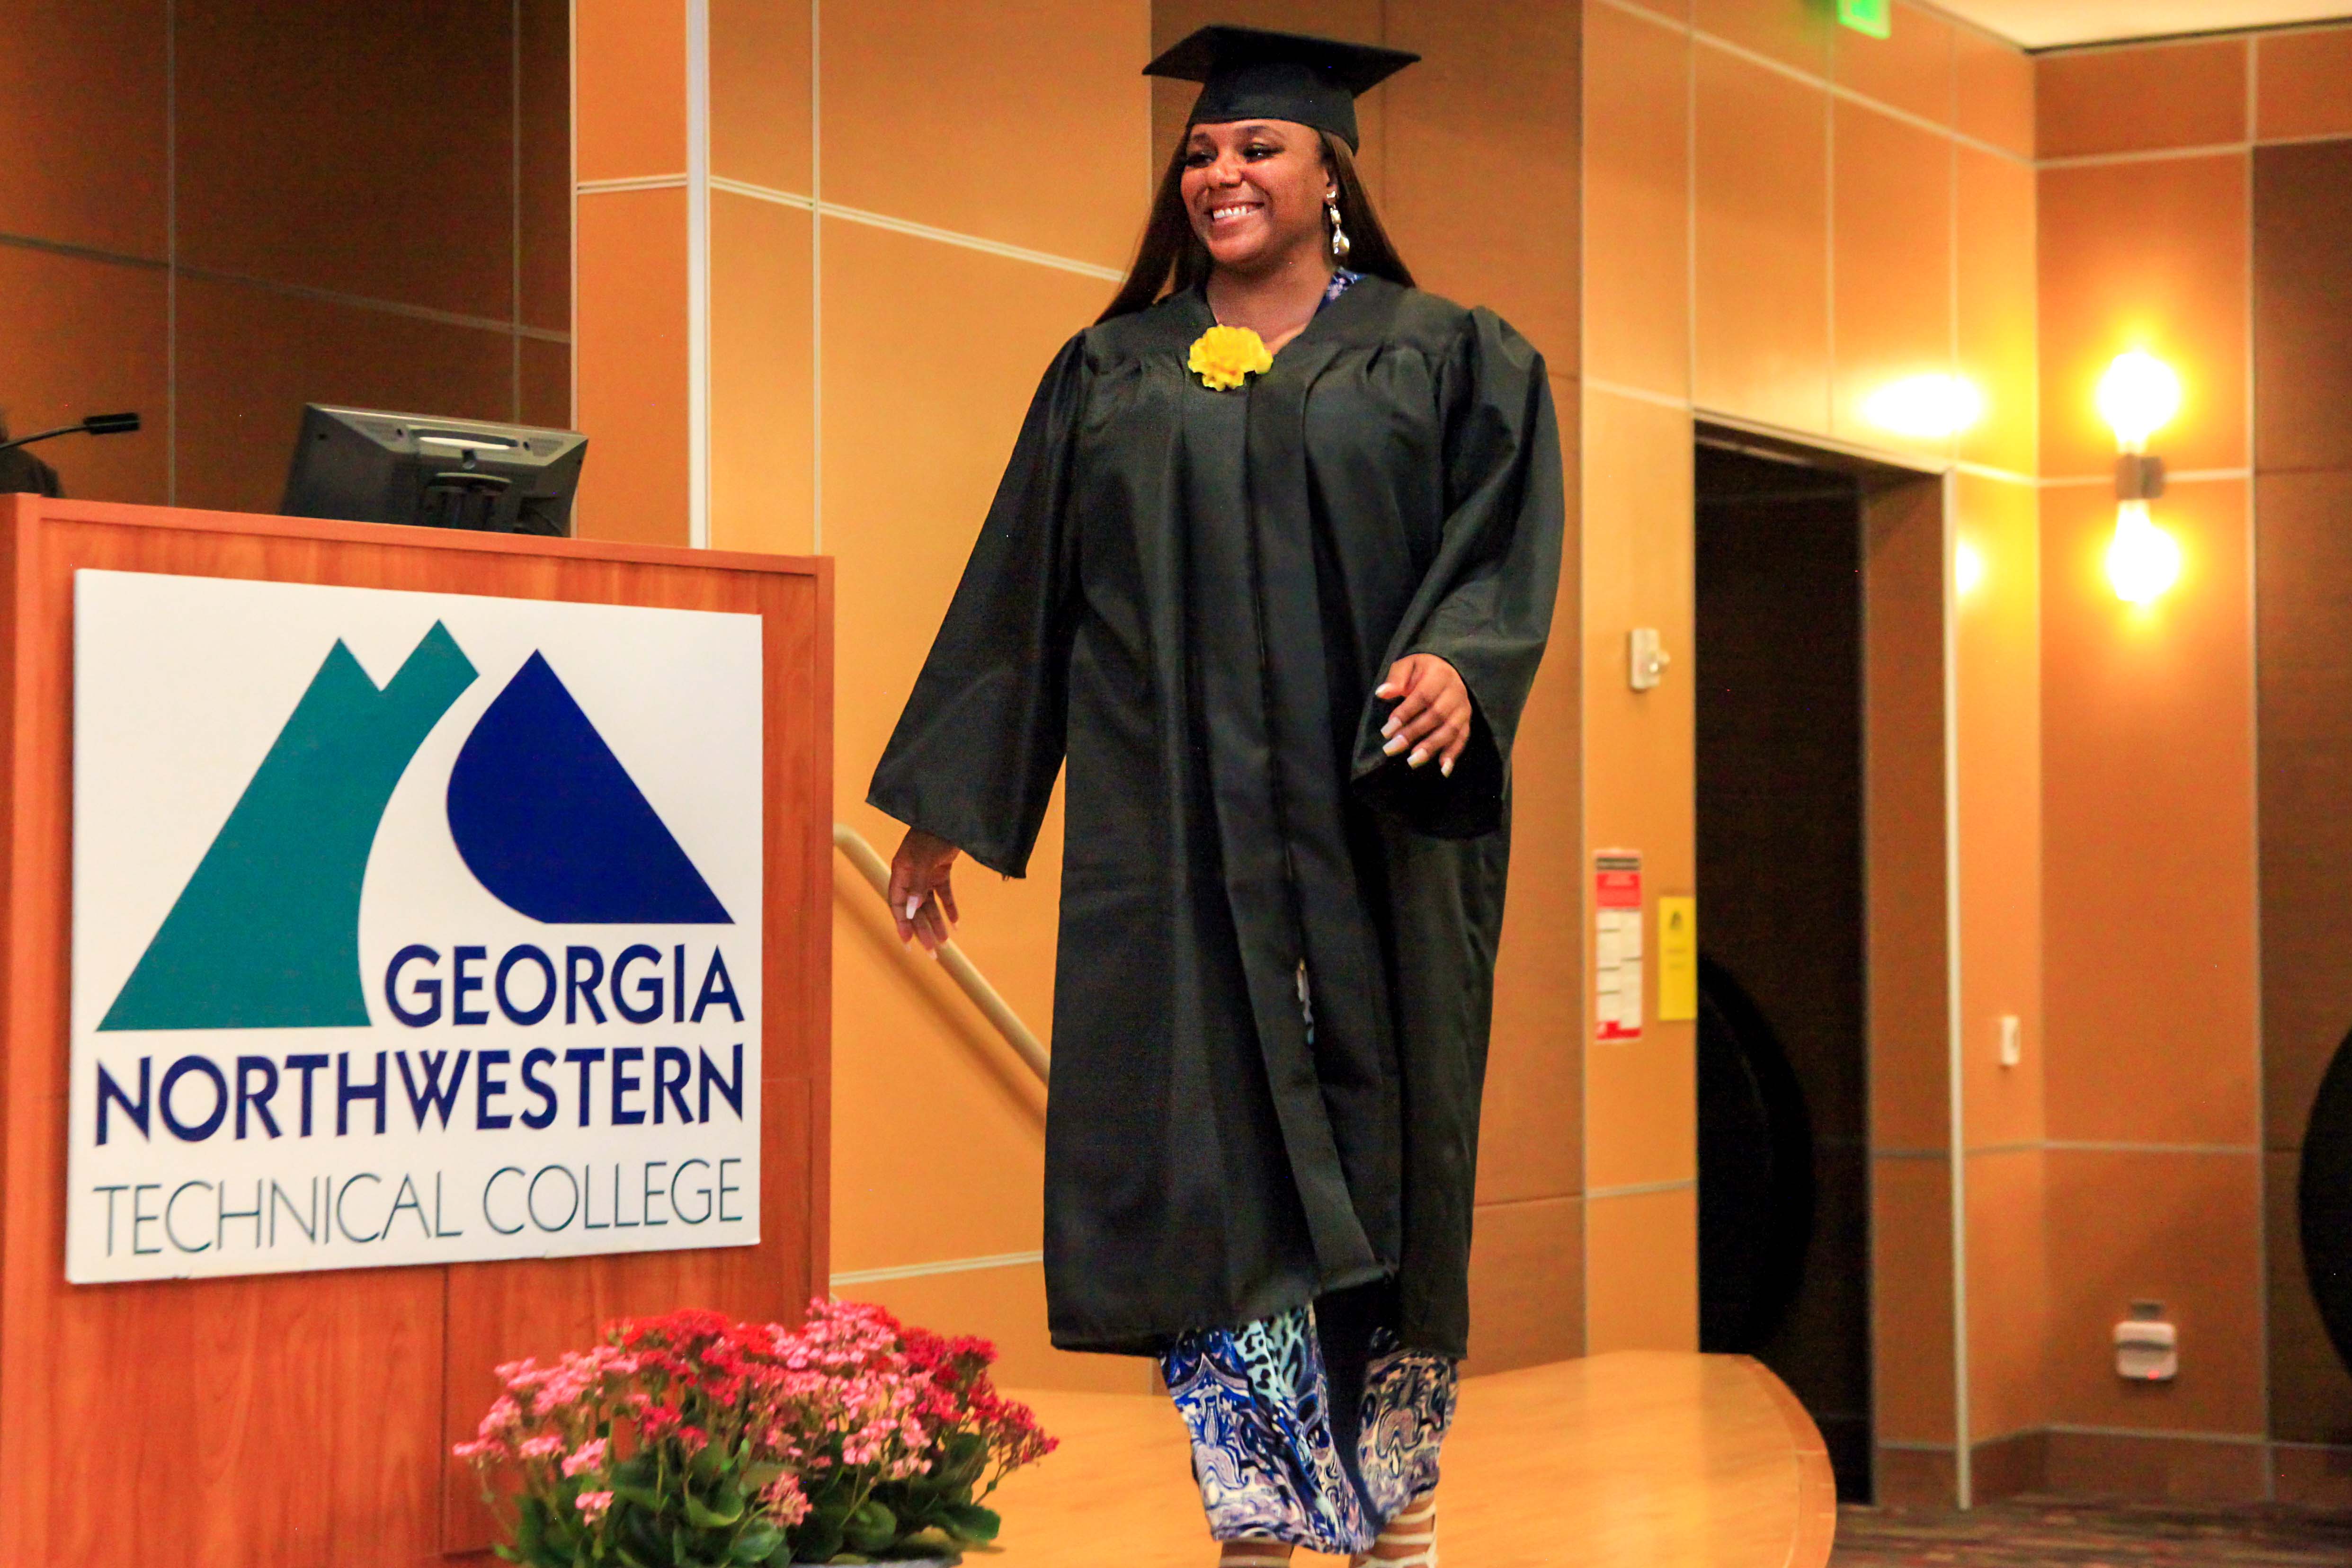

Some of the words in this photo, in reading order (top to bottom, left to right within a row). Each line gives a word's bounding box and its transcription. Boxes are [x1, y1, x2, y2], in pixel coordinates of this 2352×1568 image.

[384, 943, 745, 1028] GEORGIA
[94, 1042, 745, 1147] NORTHWESTERN
[92, 1170, 464, 1257] TECHNICAL
[482, 1158, 744, 1235] COLLEGE
